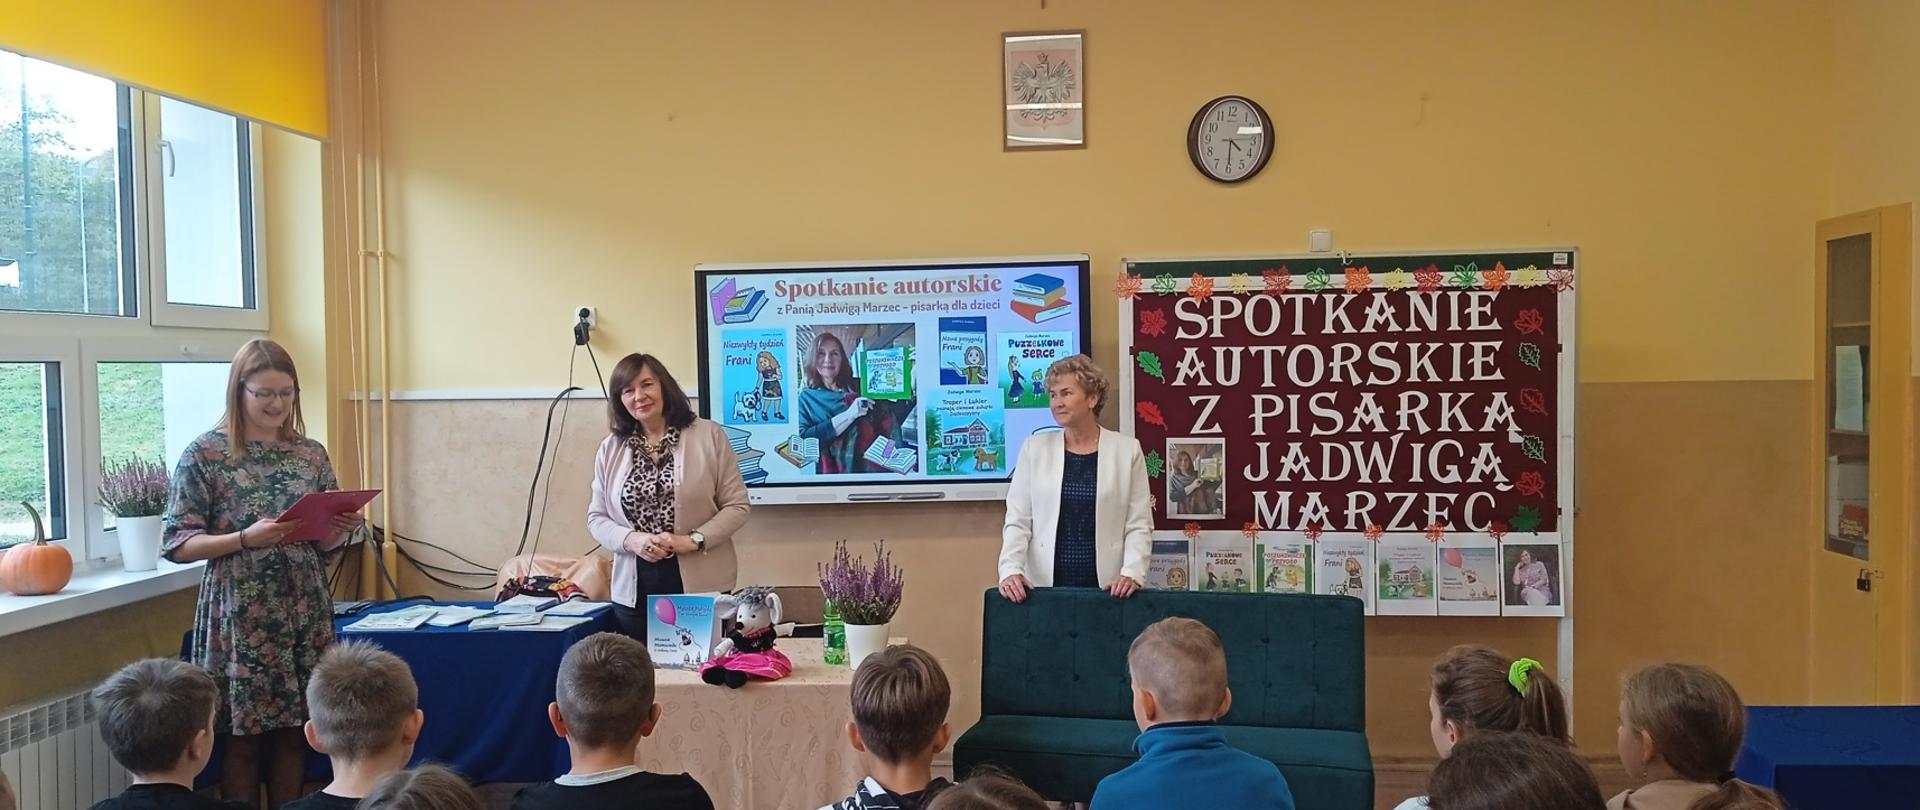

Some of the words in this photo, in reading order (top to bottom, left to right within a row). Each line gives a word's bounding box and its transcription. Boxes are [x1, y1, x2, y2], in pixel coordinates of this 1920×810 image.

[1217, 111, 1224, 121] 11
[1228, 105, 1238, 117] 12
[1209, 122, 1218, 133] 10
[1205, 134, 1212, 144] 9
[1250, 136, 1256, 146] 3
[1207, 146, 1213, 157] 8
[1246, 148, 1252, 158] 4
[1214, 158, 1220, 169] 7
[1225, 163, 1232, 174] 6
[1239, 160, 1245, 169] 5
[774, 277, 888, 301] Spotkanie
[893, 274, 1002, 295] autorskie
[777, 306, 783, 315] z
[785, 304, 814, 317] Panią
[816, 302, 860, 316] Jadwigą
[863, 302, 901, 313] Marzec
[911, 300, 949, 315] pisarką
[951, 299, 968, 311] dla
[970, 299, 1001, 311] dzieci
[1174, 291, 1502, 340] SPOTKANIE
[726, 353, 753, 366] Frani
[1171, 341, 1505, 388] AUTORSKIE
[1189, 395, 1223, 434] Z
[1244, 433, 1515, 491] JADWIGĄ
[1251, 490, 1496, 532] MARZEC
